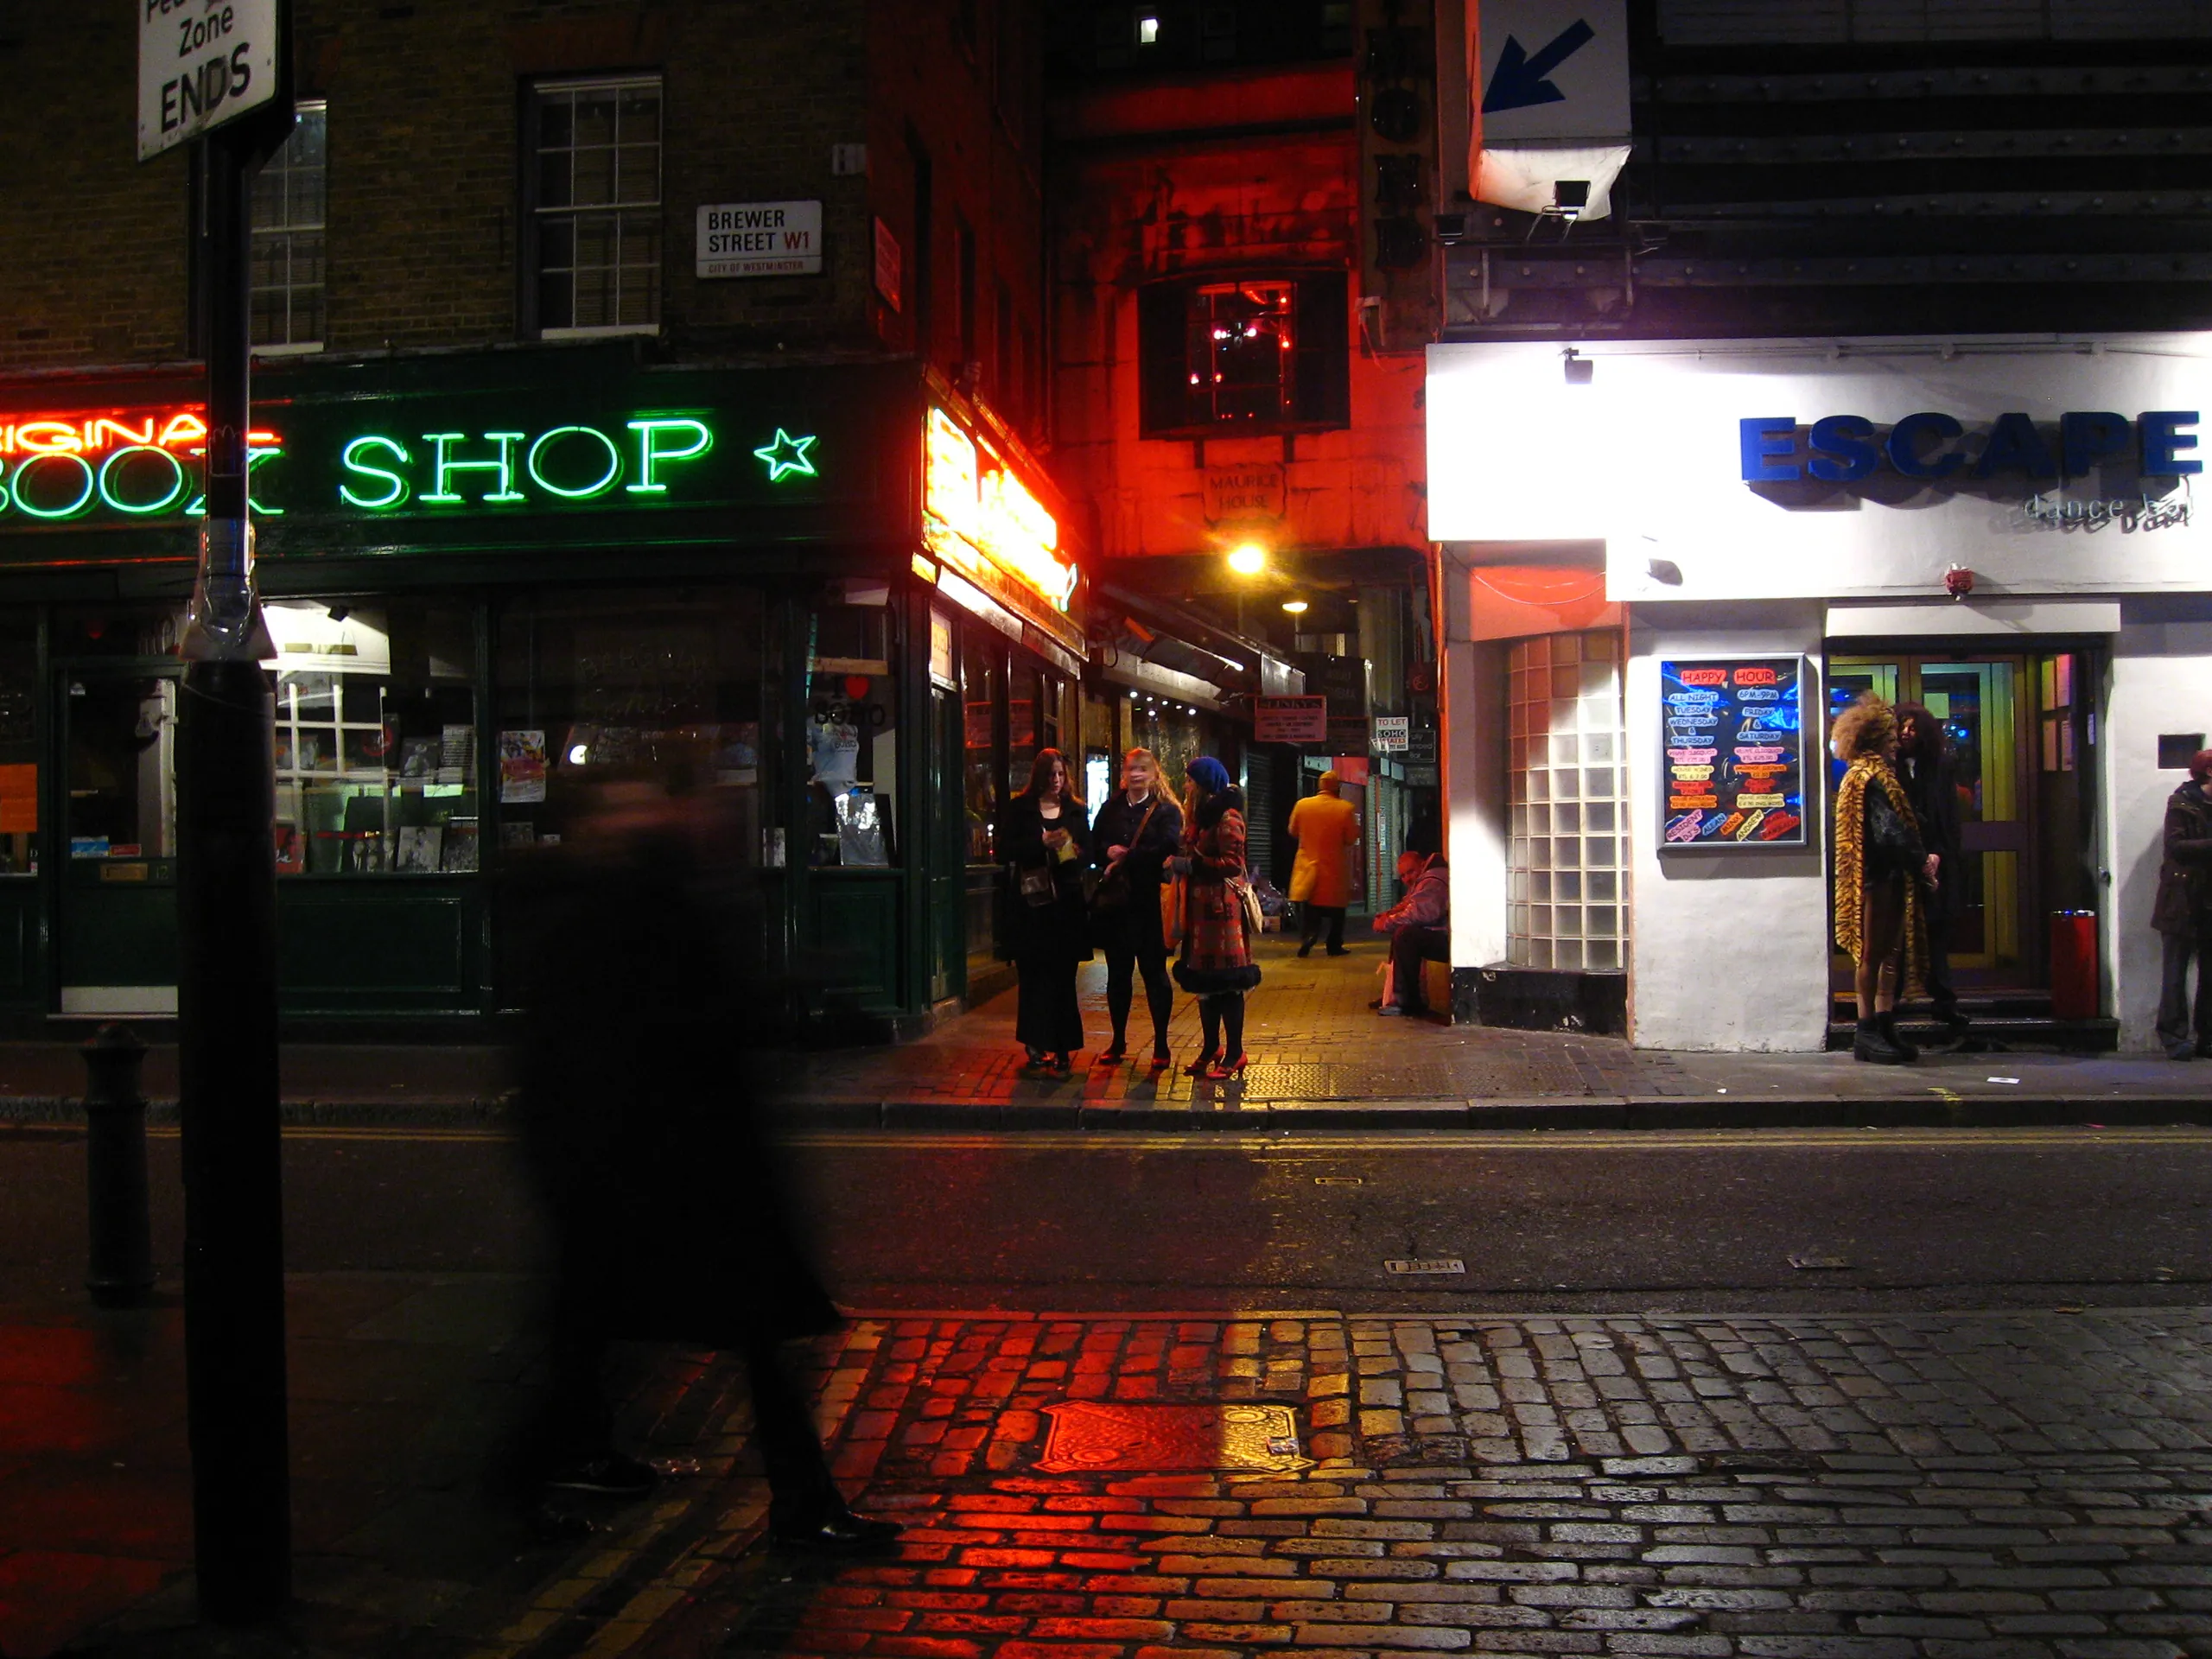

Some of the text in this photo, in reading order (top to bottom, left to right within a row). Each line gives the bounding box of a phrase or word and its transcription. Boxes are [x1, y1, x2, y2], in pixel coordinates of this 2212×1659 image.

[179, 5, 233, 58] Zone
[162, 41, 251, 134] ENDS
[709, 210, 785, 231] BREWER
[709, 232, 810, 252] STREET W1
[708, 261, 804, 273] CITY OF WESTMINSTER
[1740, 411, 2202, 481] ESCAPE
[340, 419, 712, 508] SHOP
[1210, 474, 1277, 490] MAURICE
[1218, 494, 1269, 511] HOUSE
[2024, 493, 2124, 519] dance
[1683, 671, 1773, 683] HAPPY HOUR
[815, 700, 886, 726] SOHO
[1668, 812, 1700, 839] RESIDENT
[1683, 827, 1700, 842] DJ'S
[1738, 811, 1762, 840] ANDREW
